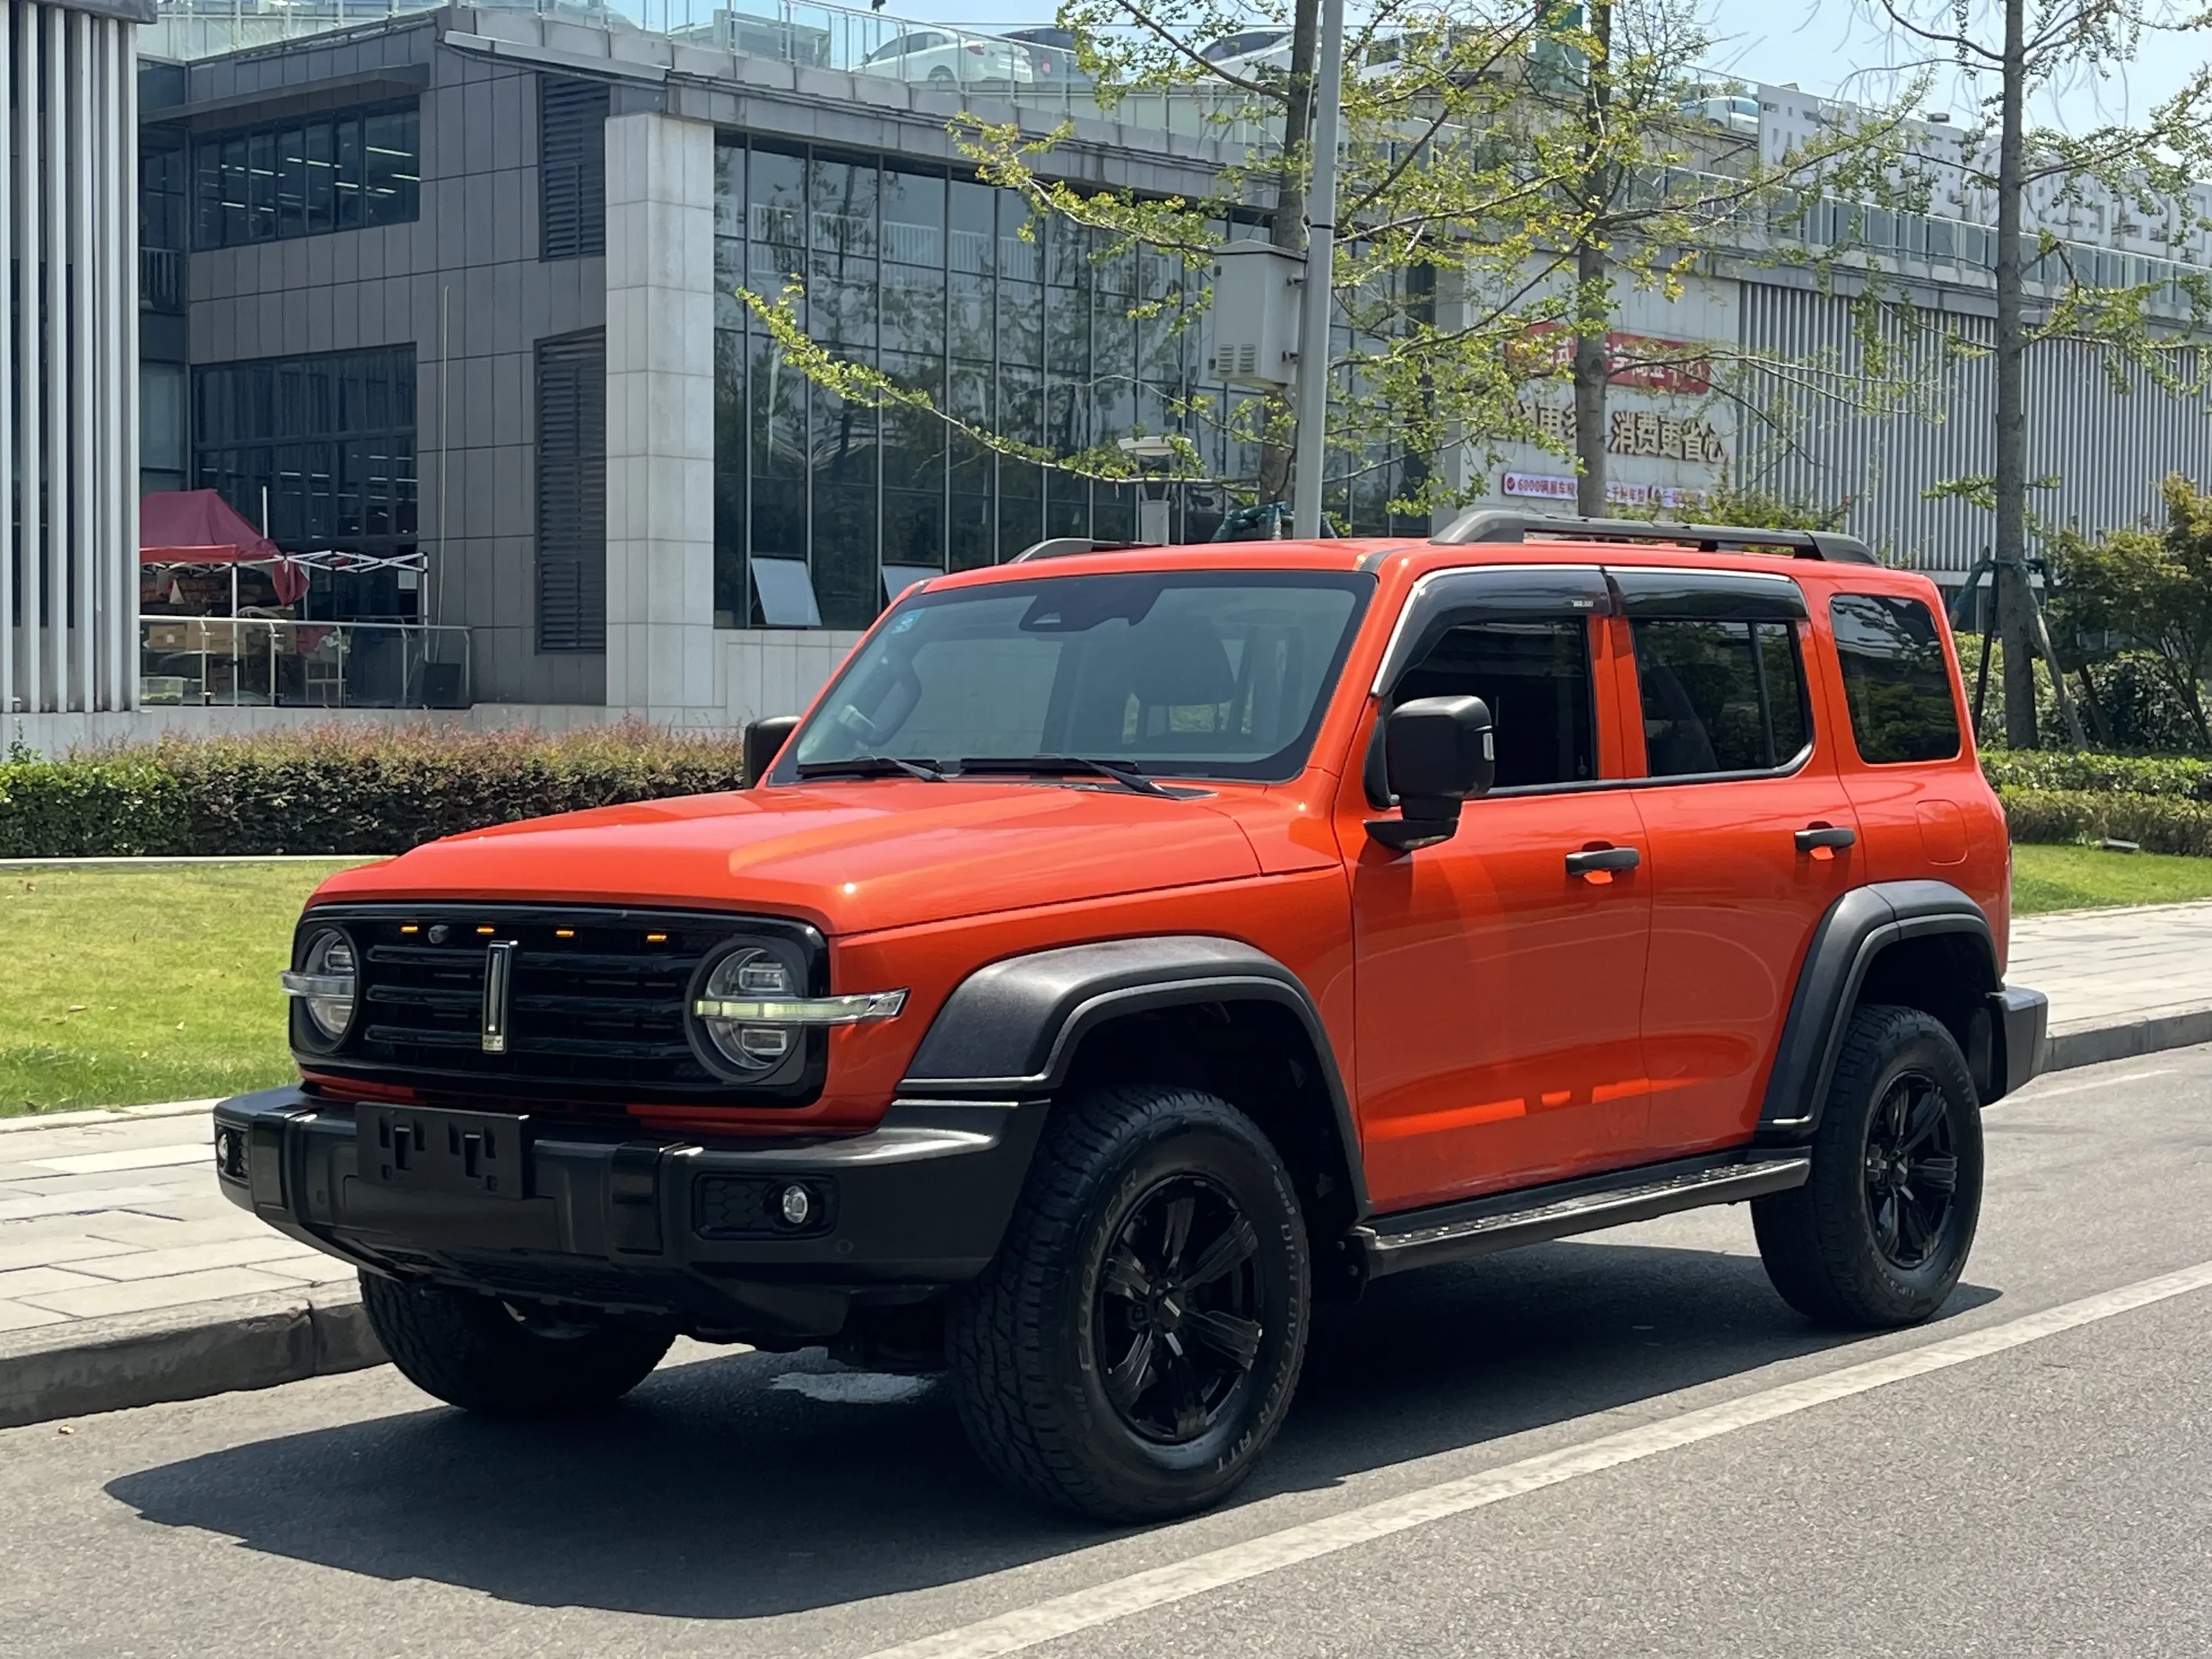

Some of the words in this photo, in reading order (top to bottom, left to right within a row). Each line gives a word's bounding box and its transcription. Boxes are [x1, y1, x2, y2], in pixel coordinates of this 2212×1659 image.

[1609, 410, 1728, 463] 消费更省心
